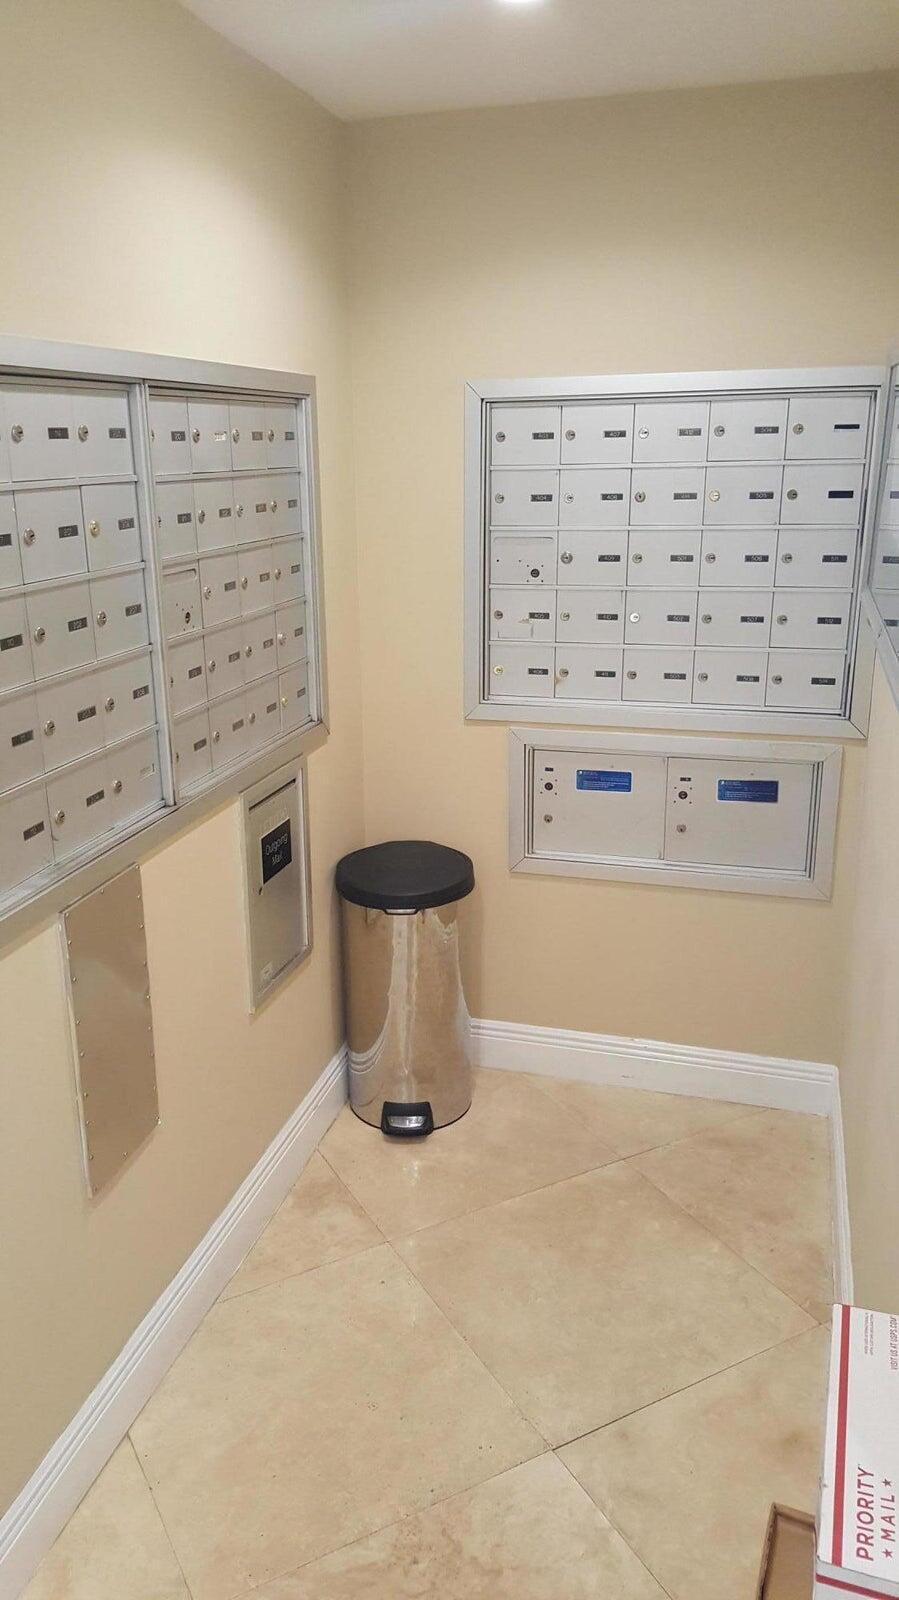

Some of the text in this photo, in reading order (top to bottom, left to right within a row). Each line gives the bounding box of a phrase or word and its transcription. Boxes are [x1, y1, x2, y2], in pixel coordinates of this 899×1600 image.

[265, 833, 288, 856] Outgoing
[890, 1349, 898, 1357] US
[856, 1466, 874, 1562] PRIORITY
[880, 1495, 896, 1542] MAIL
